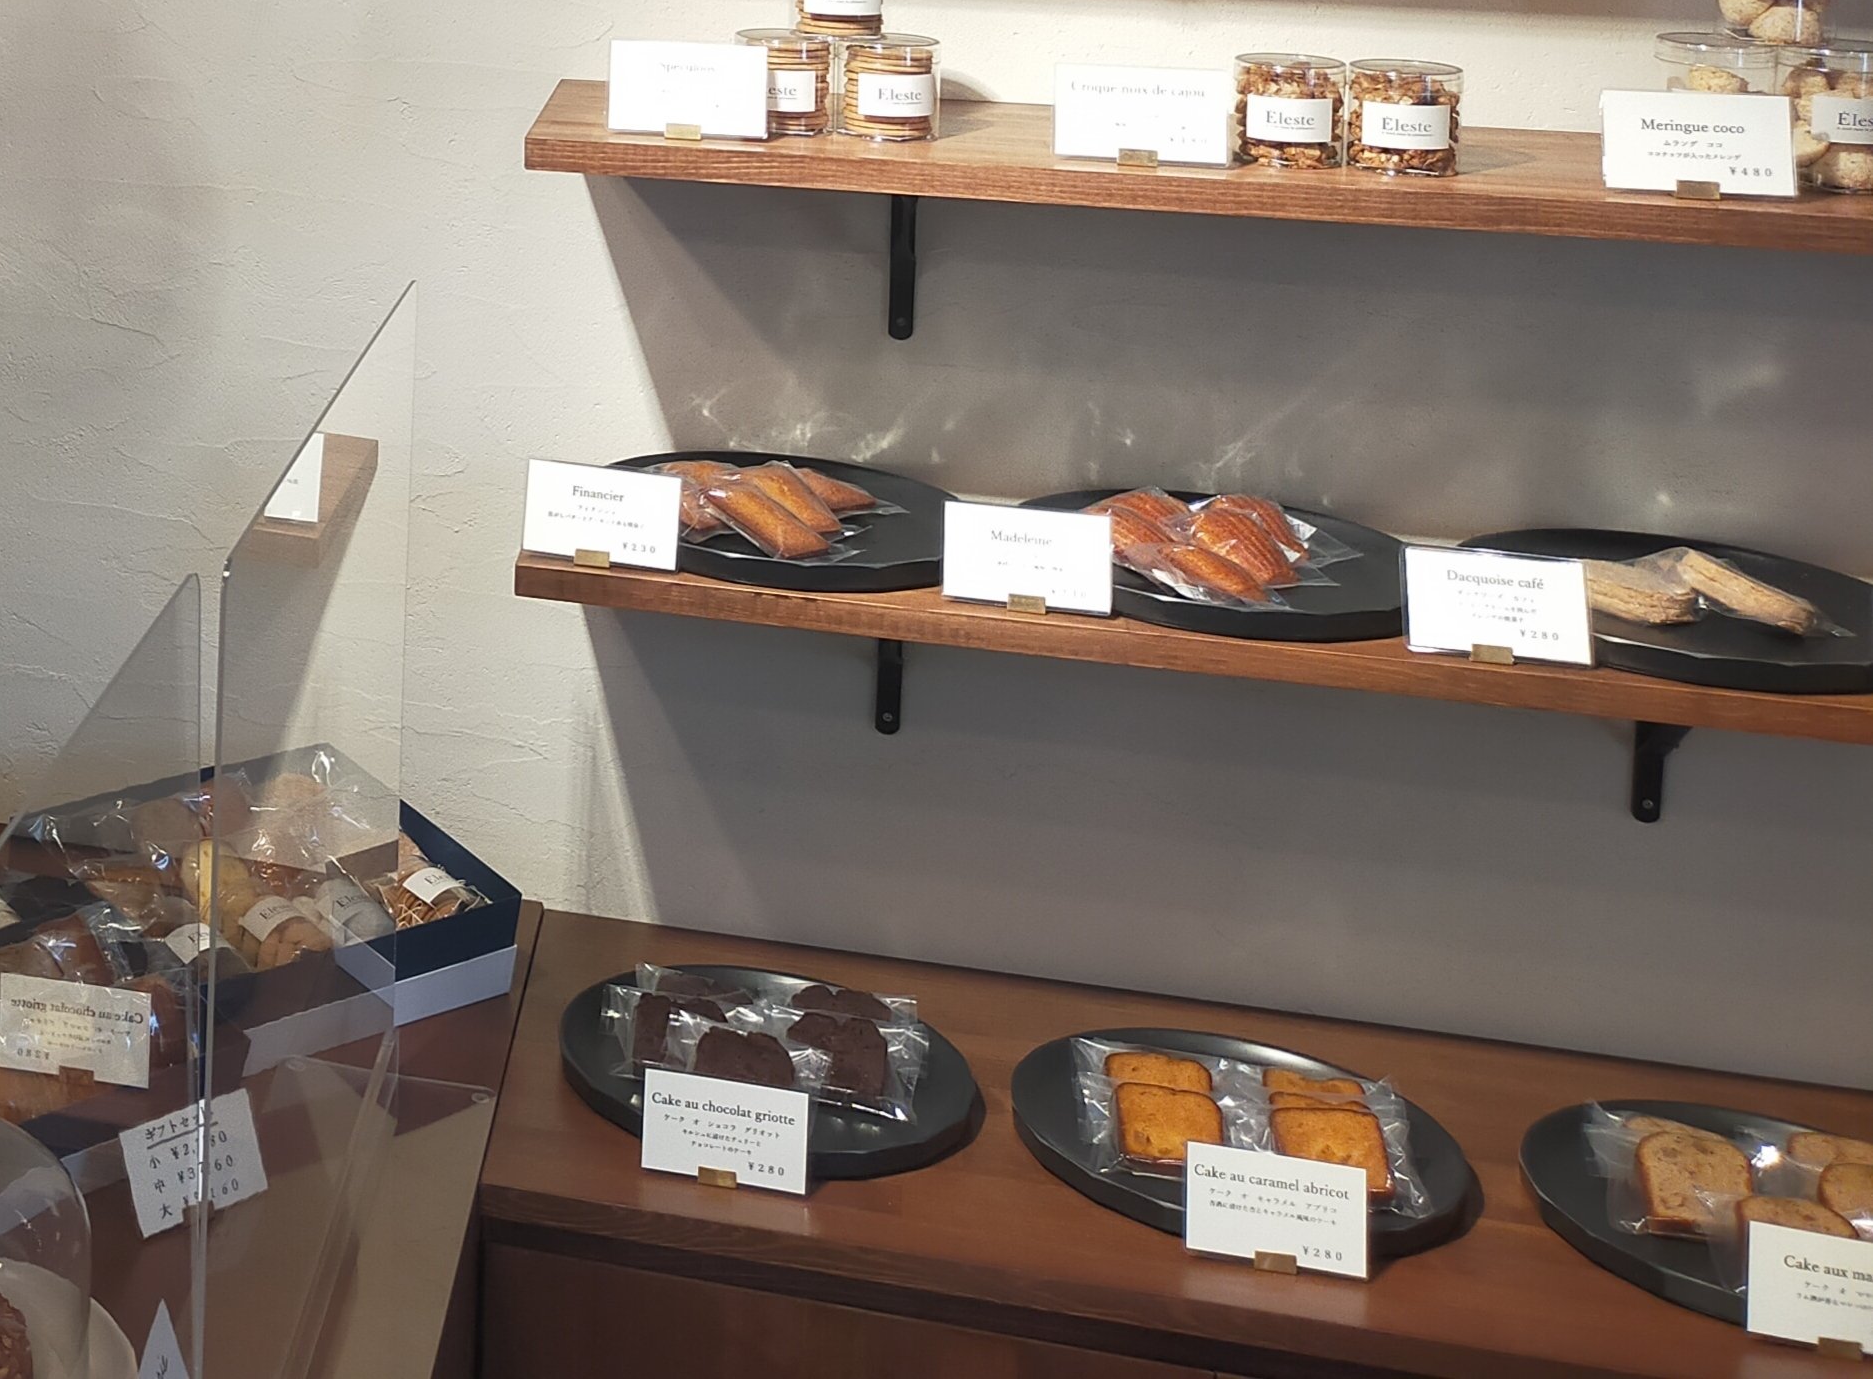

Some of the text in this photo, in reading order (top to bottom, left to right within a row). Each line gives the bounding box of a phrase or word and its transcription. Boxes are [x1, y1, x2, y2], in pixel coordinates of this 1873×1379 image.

[1641, 118, 1745, 135] Meringue coco
[572, 485, 625, 503] Financier
[1446, 568, 1545, 590] Dacquoise café
[651, 1091, 796, 1126] Cake au chocolat griotte
[149, 1155, 161, 1169] 小
[154, 1179, 166, 1194] 中
[1194, 1163, 1351, 1201] Cake au caramel abricot
[159, 1203, 173, 1219] 大
[1783, 1254, 1820, 1273] Cake
[1823, 1265, 1849, 1279] aux
